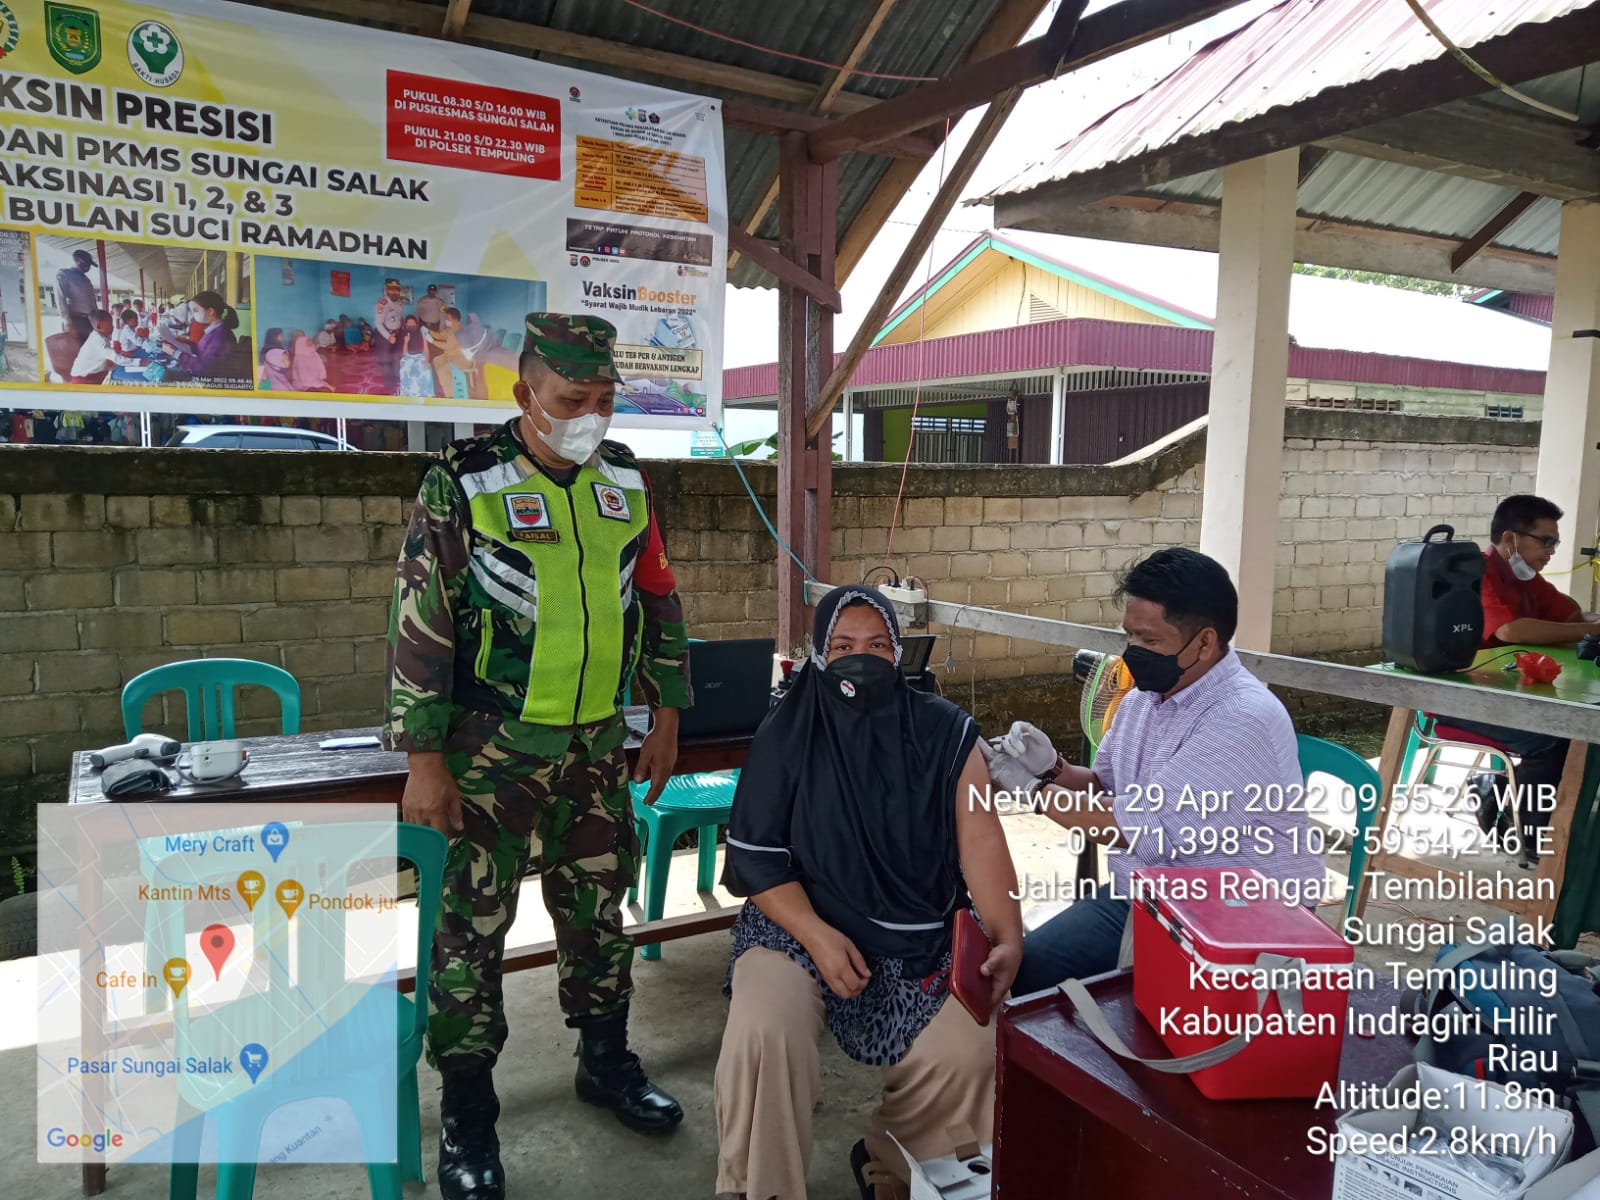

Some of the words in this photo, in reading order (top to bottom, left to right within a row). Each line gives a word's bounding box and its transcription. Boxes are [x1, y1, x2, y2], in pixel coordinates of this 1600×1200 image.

[133, 62, 152, 81] BAKTI
[155, 69, 180, 84] HUSADA
[116, 91, 272, 144] PRESISI
[394, 99, 406, 110] DI
[409, 101, 475, 120] PUSKESMAS
[477, 112, 517, 127] SUNGAI
[520, 118, 555, 133] SALAH
[403, 89, 440, 104] PUKUL
[443, 96, 472, 108] 08.30
[474, 100, 494, 111] S/D
[496, 104, 523, 116] 14.00
[526, 108, 547, 120] WIB
[404, 125, 441, 139] PUKUL
[443, 130, 471, 143] 21.00
[474, 135, 493, 146] S/D
[495, 138, 522, 150] 22.30
[524, 142, 545, 154] WIB
[415, 138, 427, 148] DI
[429, 139, 471, 155] POLSEK
[474, 146, 536, 164] TEMPULING
[0, 128, 64, 158] AN
[77, 136, 181, 173] PKMS
[192, 151, 317, 188] SUNGAI
[327, 167, 430, 202] SALAK
[174, 182, 197, 210] 1,
[207, 186, 234, 214] 2,
[244, 190, 266, 213] &
[275, 193, 294, 217] 3
[9, 196, 139, 234] BULAN
[151, 212, 229, 241] SUCI
[241, 222, 428, 260] RAMADHAN
[582, 281, 697, 304] VaksinBooster
[609, 302, 627, 311] Wajib
[629, 303, 649, 312] Mudik
[614, 361, 633, 369] UDAH
[670, 364, 699, 373] LENGKAP
[626, 351, 636, 359] TES
[638, 352, 650, 360] PCR
[657, 353, 686, 361] ANTIGEN
[1452, 624, 1473, 633] XPL
[1401, 1165, 1458, 1195] INSTRUCTIONS
[1415, 1164, 1459, 1189] PEMAKAIAN
